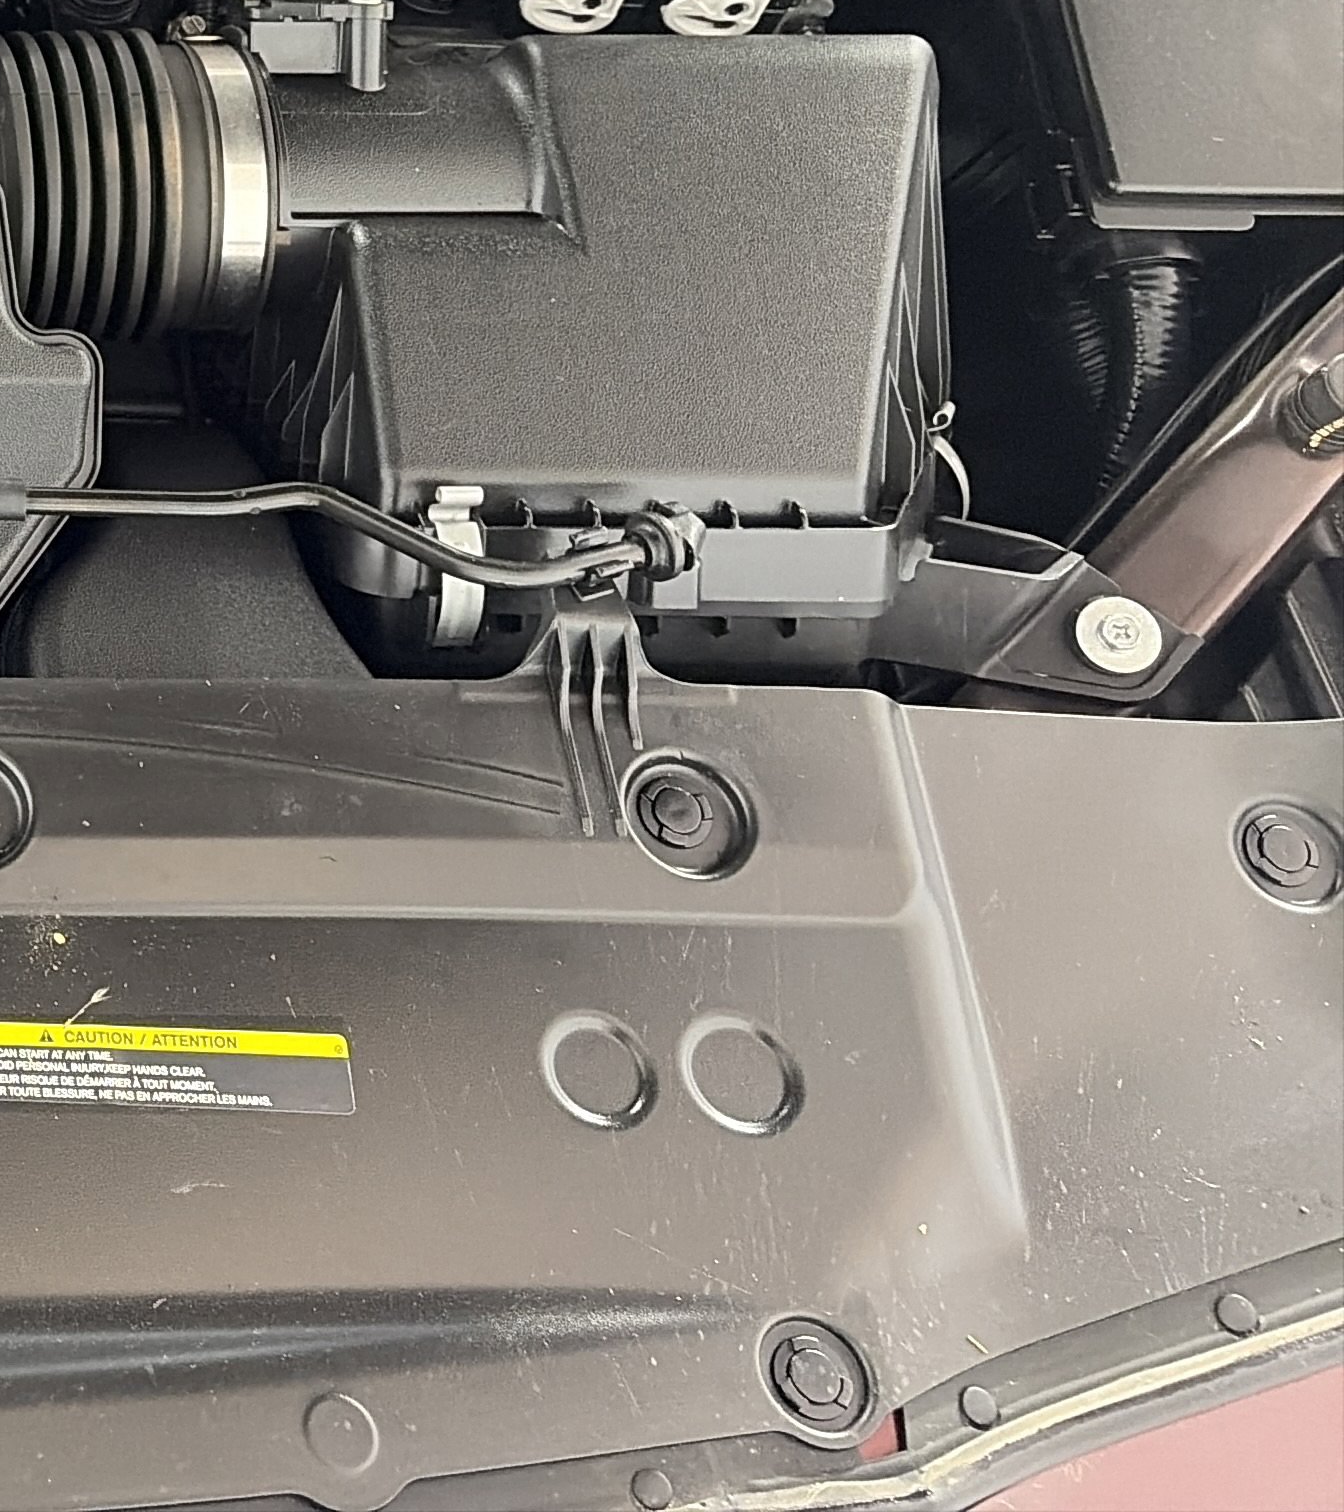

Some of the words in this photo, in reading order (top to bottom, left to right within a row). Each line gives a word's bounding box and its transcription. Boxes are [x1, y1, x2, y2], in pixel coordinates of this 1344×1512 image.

[64, 1030, 133, 1045] CAUTION
[140, 1033, 146, 1044] /
[152, 1034, 238, 1048] ATTENTION
[19, 1049, 50, 1060] START
[52, 1050, 64, 1060] AT
[65, 1050, 87, 1060] ANY
[88, 1051, 113, 1061] TIME.
[16, 1061, 70, 1072] PERSONAL
[132, 1065, 168, 1076] HANDS
[170, 1066, 206, 1077] CLEAR.
[21, 1075, 59, 1086] RISQUE
[61, 1076, 75, 1086] DE
[76, 1075, 132, 1088] DÉMARRER
[133, 1076, 141, 1088] À
[143, 1078, 168, 1090] TOUT
[8, 1086, 41, 1097] TOUTE
[42, 1088, 98, 1100] BLESSURE,
[99, 1089, 113, 1100] NE
[115, 1090, 134, 1100] PAS
[136, 1091, 150, 1101] EN
[152, 1092, 216, 1104] APPROCHER
[217, 1094, 236, 1104] LES
[238, 1095, 273, 1107] MAINS.
